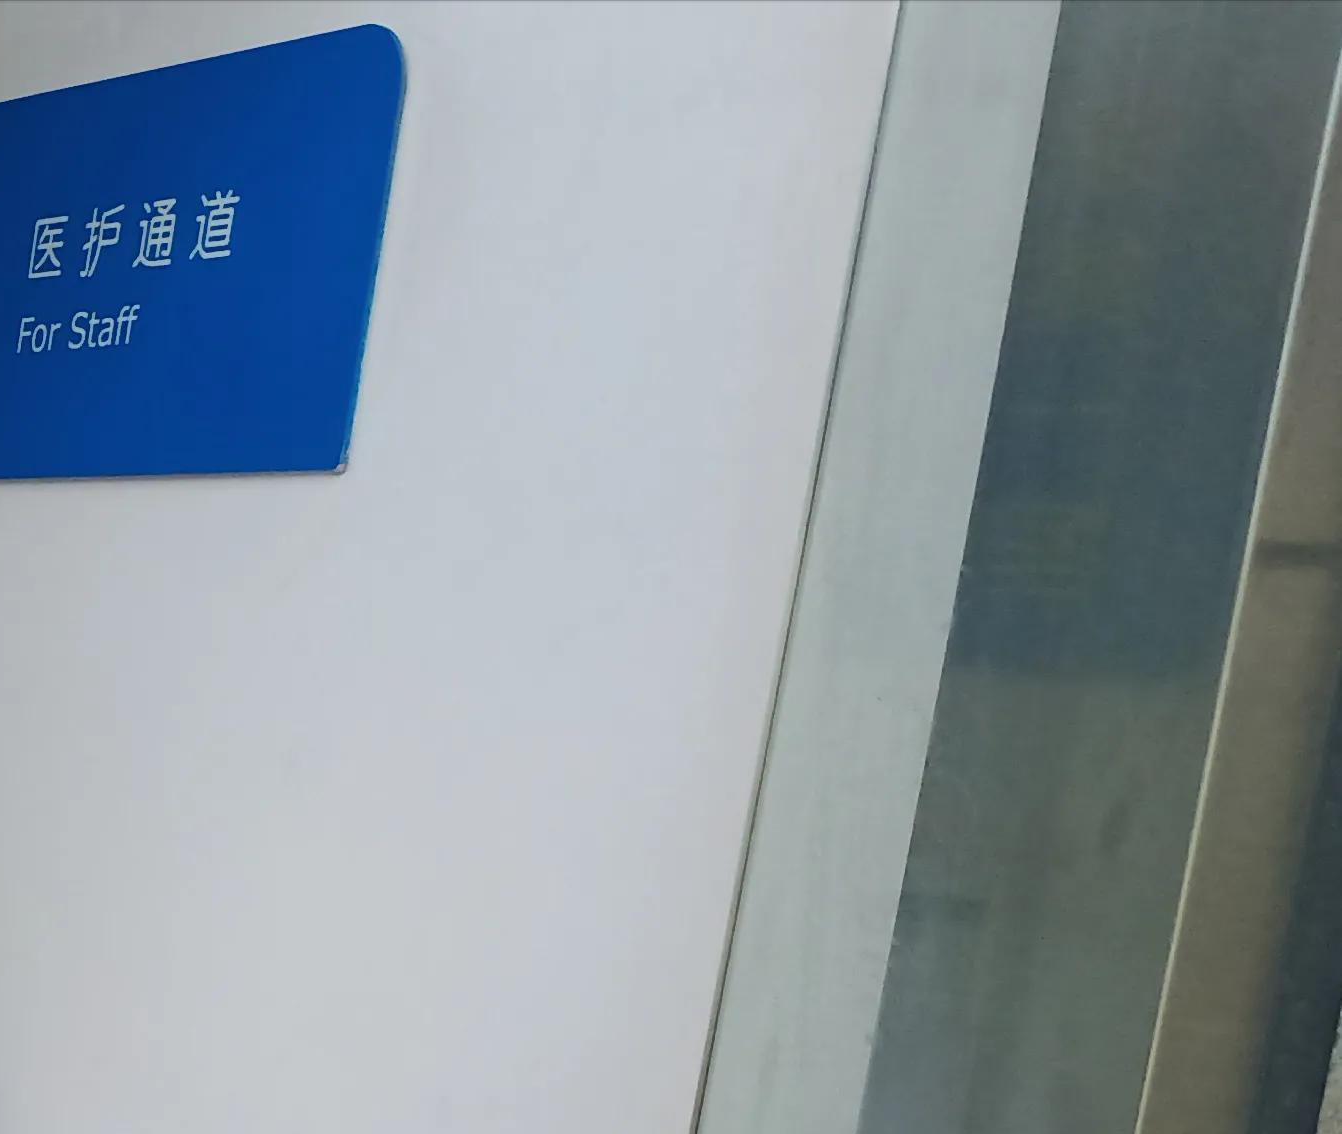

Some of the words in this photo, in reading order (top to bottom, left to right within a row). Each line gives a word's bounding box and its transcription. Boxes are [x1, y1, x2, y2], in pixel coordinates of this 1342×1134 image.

[28, 190, 241, 279] 医护通道
[17, 317, 61, 353] For
[68, 304, 141, 350] Staff
